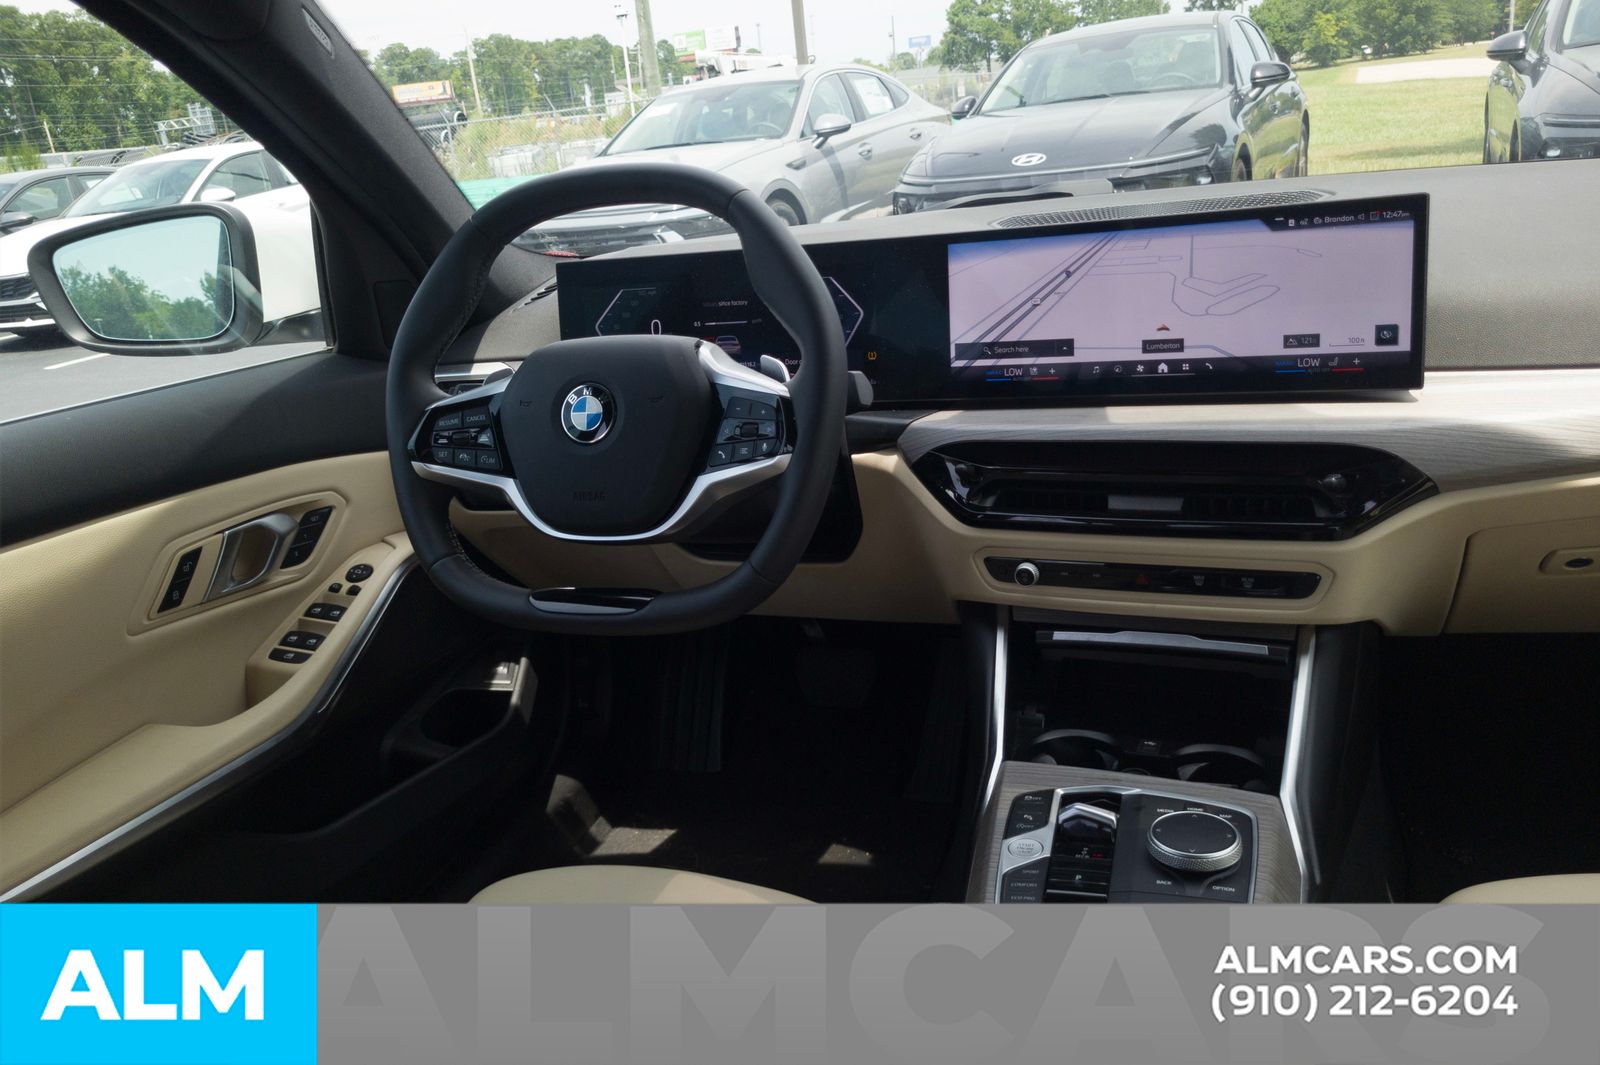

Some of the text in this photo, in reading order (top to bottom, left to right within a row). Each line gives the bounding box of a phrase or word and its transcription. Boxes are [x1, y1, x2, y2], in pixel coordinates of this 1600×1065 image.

[1324, 215, 1354, 223] Brandon
[994, 346, 1014, 354] Search
[1146, 342, 1181, 350] Lumberton
[1297, 357, 1320, 368] LOW
[1004, 367, 1023, 377] LOW
